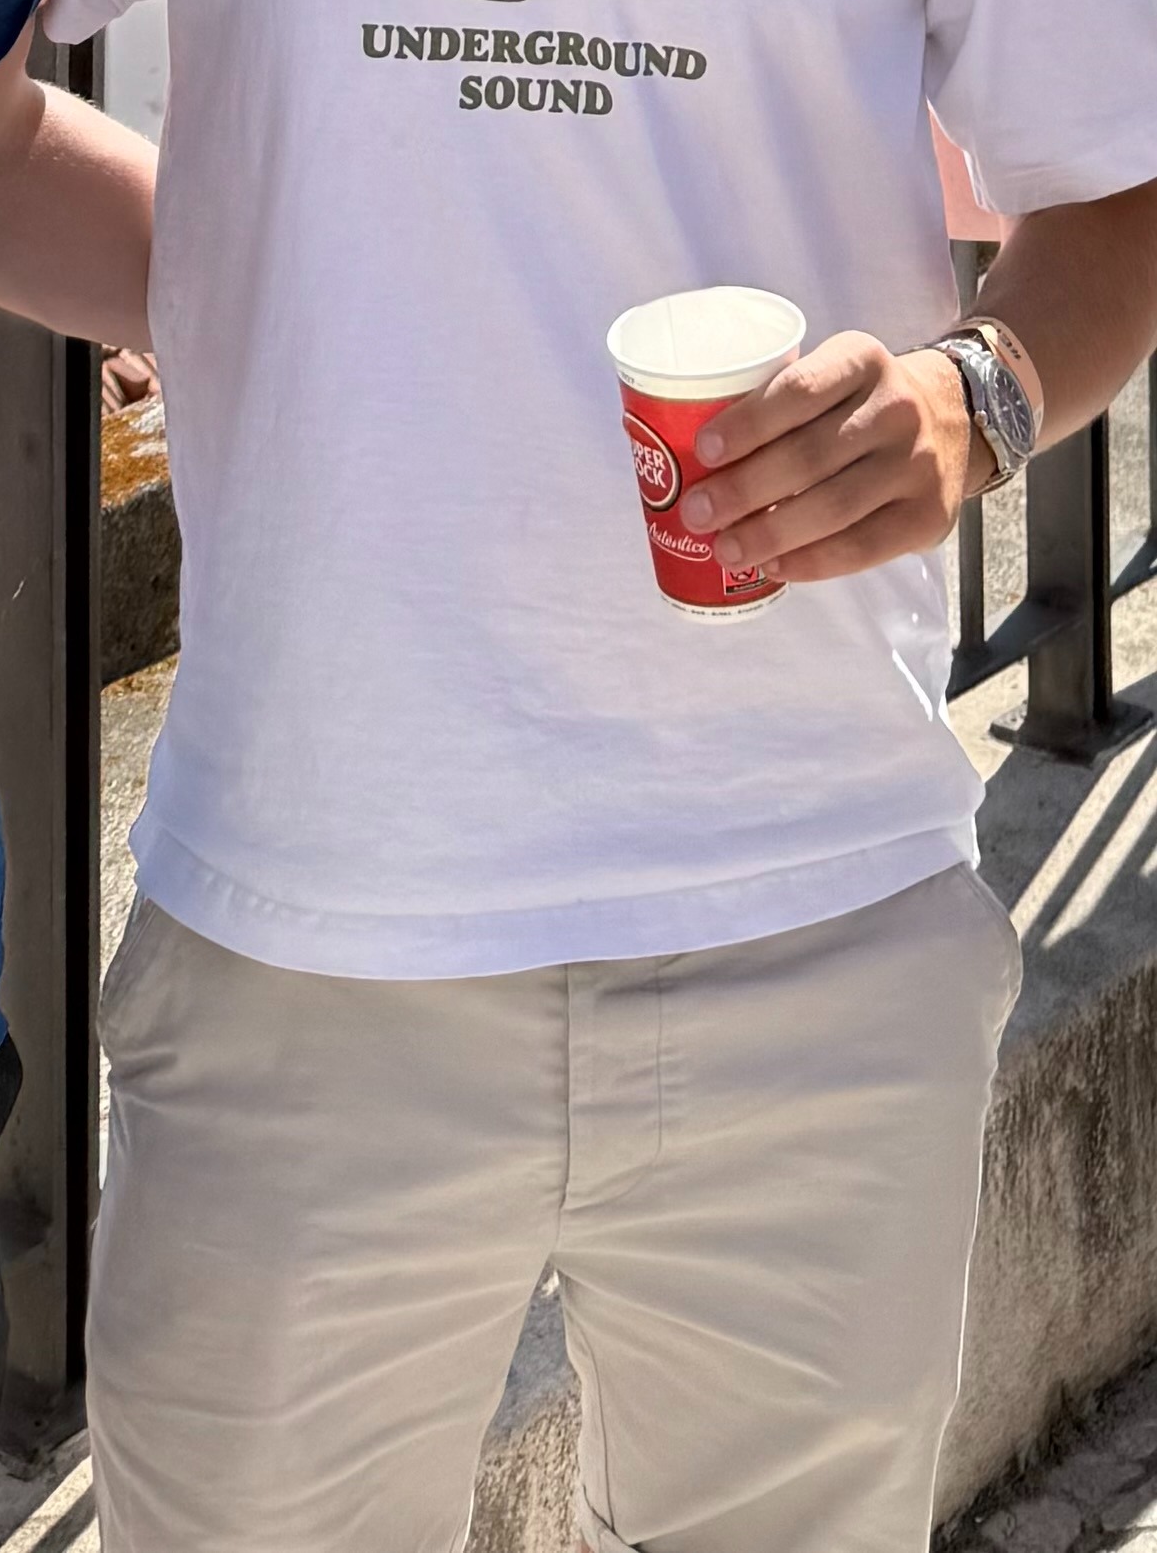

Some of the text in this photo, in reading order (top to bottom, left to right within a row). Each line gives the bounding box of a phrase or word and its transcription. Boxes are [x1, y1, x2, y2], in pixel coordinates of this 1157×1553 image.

[362, 24, 707, 80] UNDERGROUND
[459, 75, 613, 115] SOUND
[632, 438, 666, 469] PER
[635, 457, 667, 488] OCK
